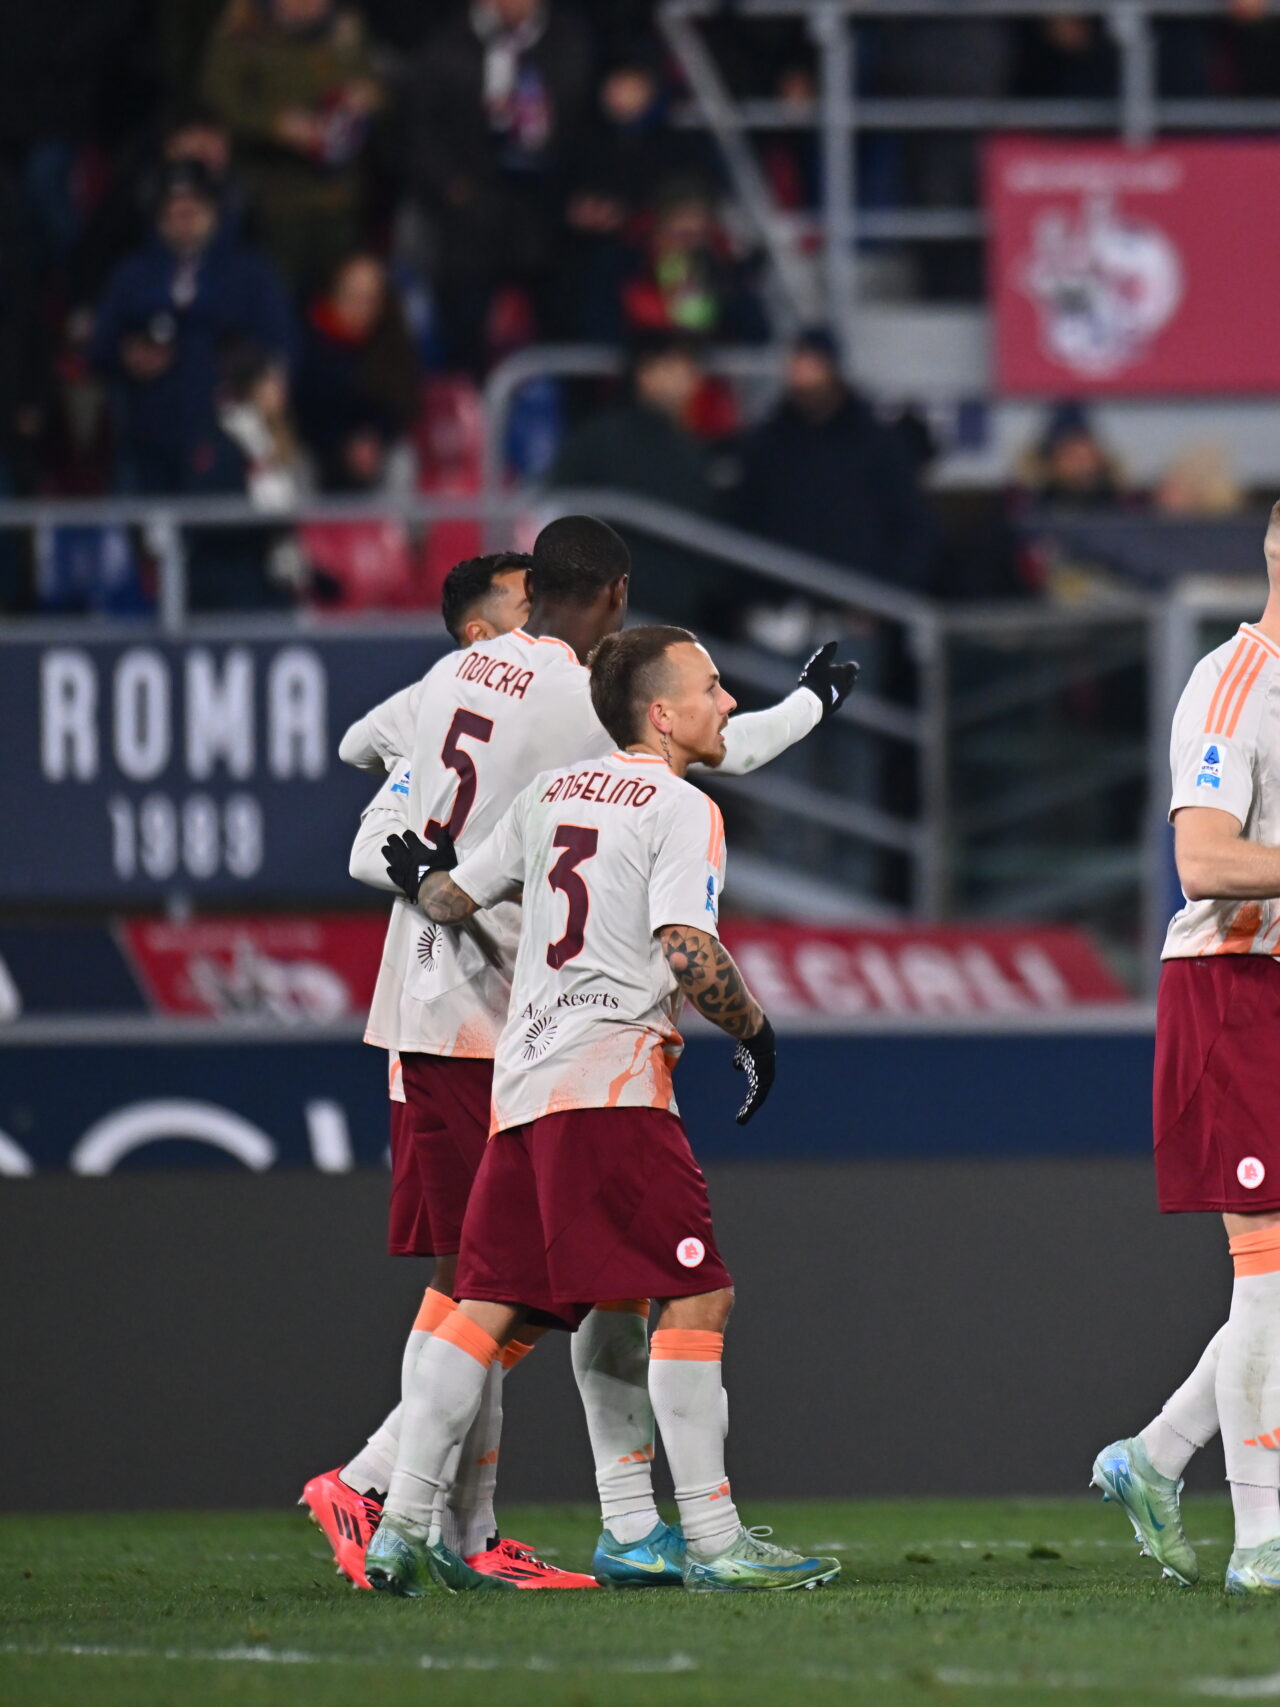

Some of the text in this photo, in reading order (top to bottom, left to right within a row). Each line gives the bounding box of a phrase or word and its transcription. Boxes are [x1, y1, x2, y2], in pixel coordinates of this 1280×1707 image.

[41, 648, 328, 782] ROMA
[456, 651, 535, 700] NDICKA
[423, 706, 495, 843] 5
[540, 771, 658, 808] ANGELIÑO
[546, 823, 599, 971] 3
[557, 992, 620, 1010] Resorts
